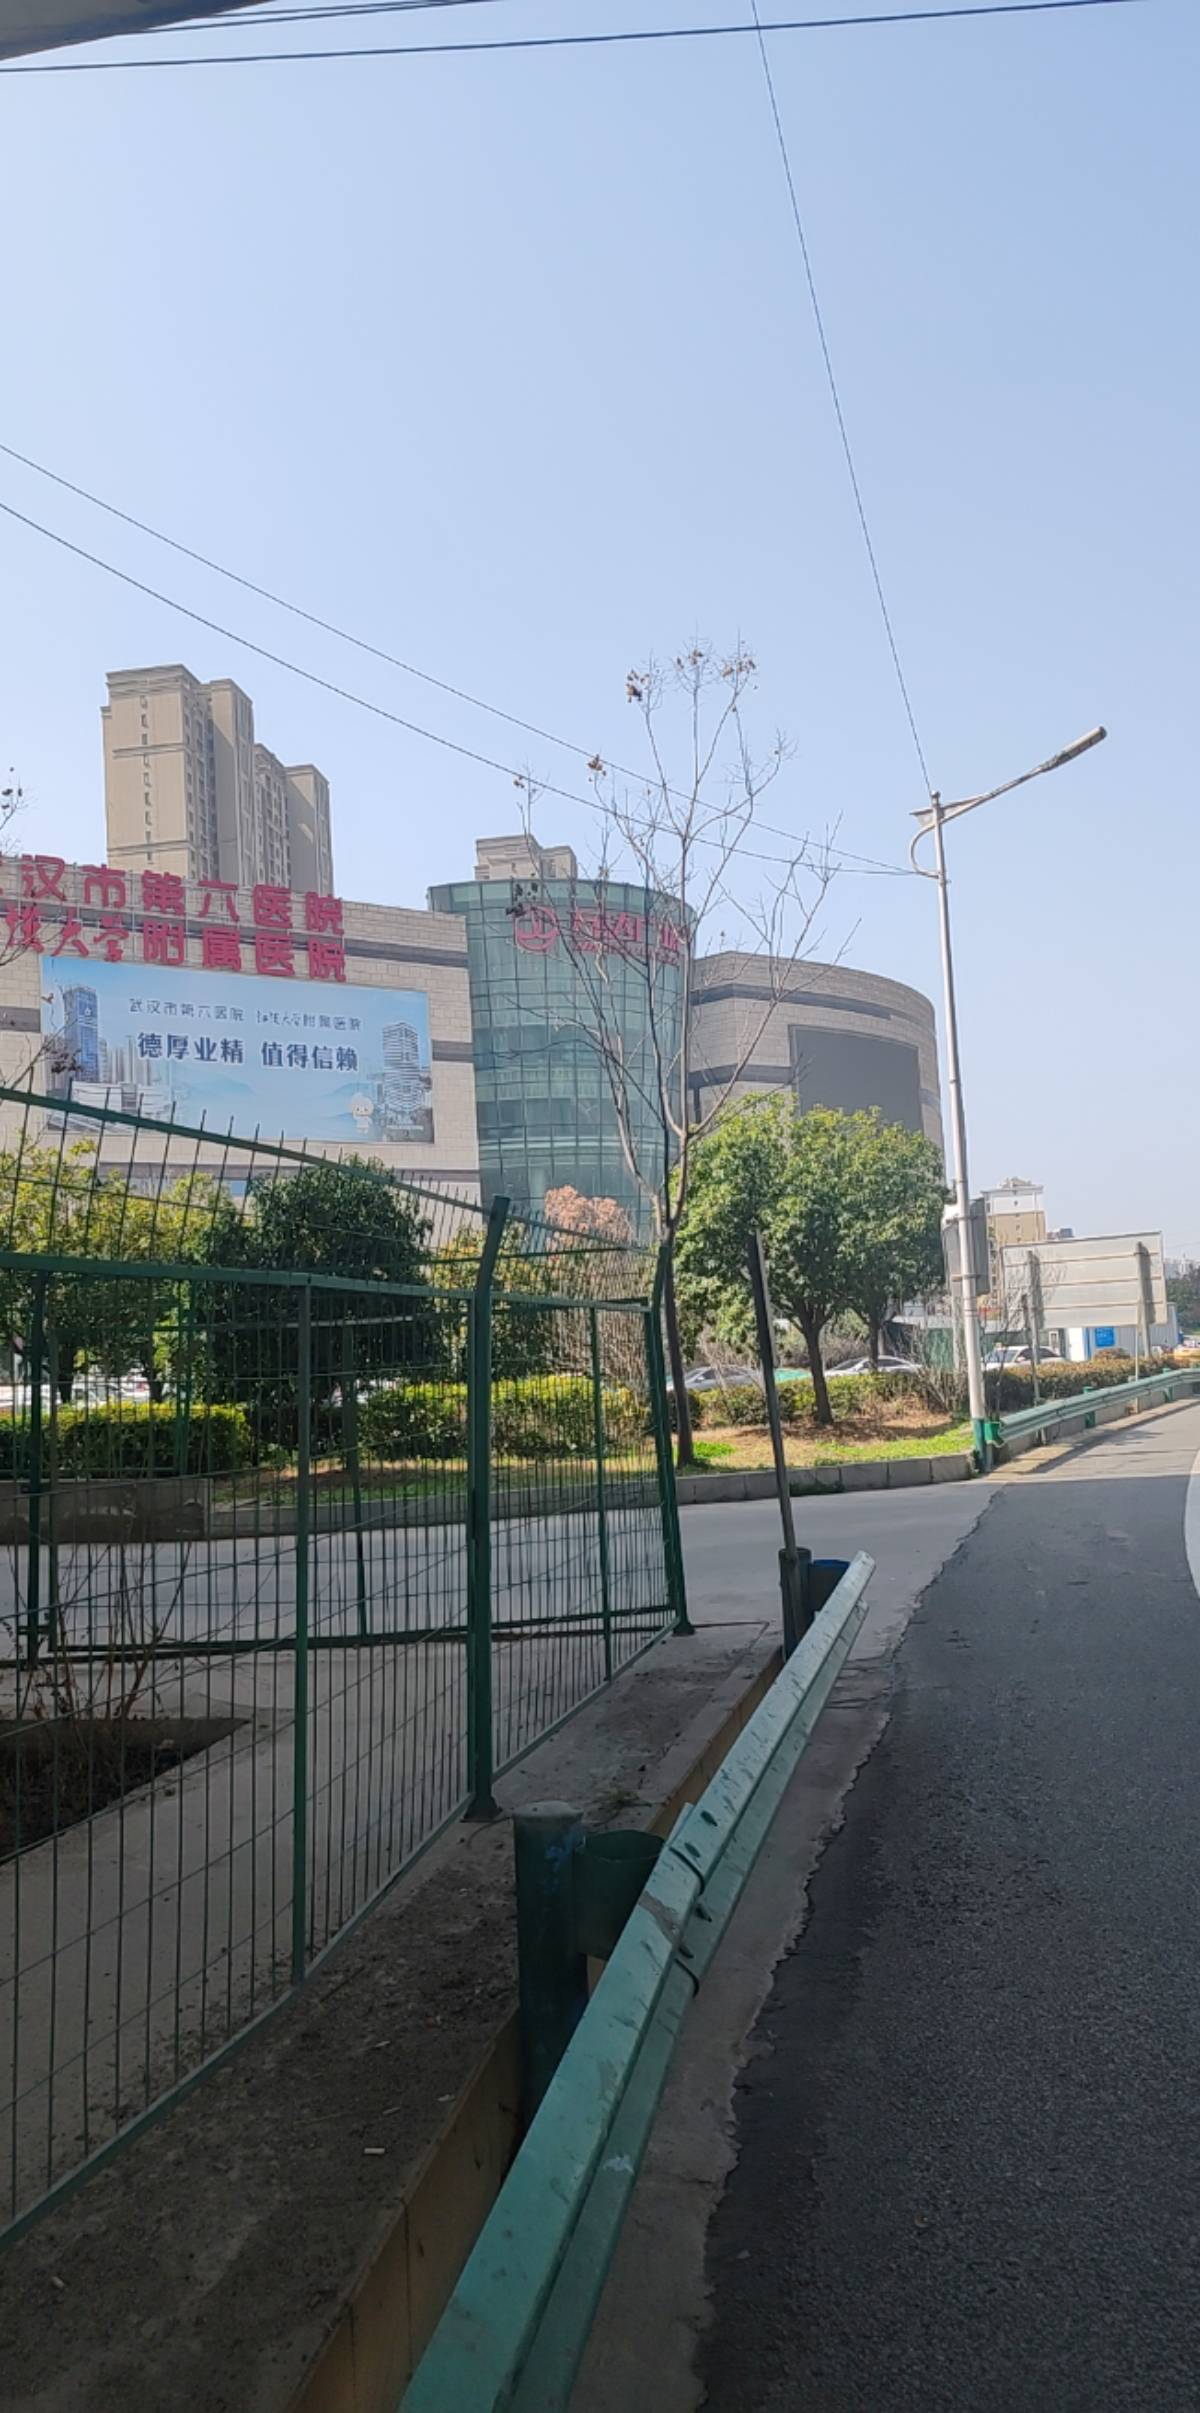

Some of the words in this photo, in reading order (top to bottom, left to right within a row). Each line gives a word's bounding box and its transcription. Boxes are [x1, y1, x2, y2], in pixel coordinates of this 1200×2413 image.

[0, 852, 345, 936] 汉市第六医院
[129, 997, 246, 1022] 武汉市第六医院
[137, 1032, 244, 1065] 德厚业精
[261, 1041, 359, 1072] 值得信赖
